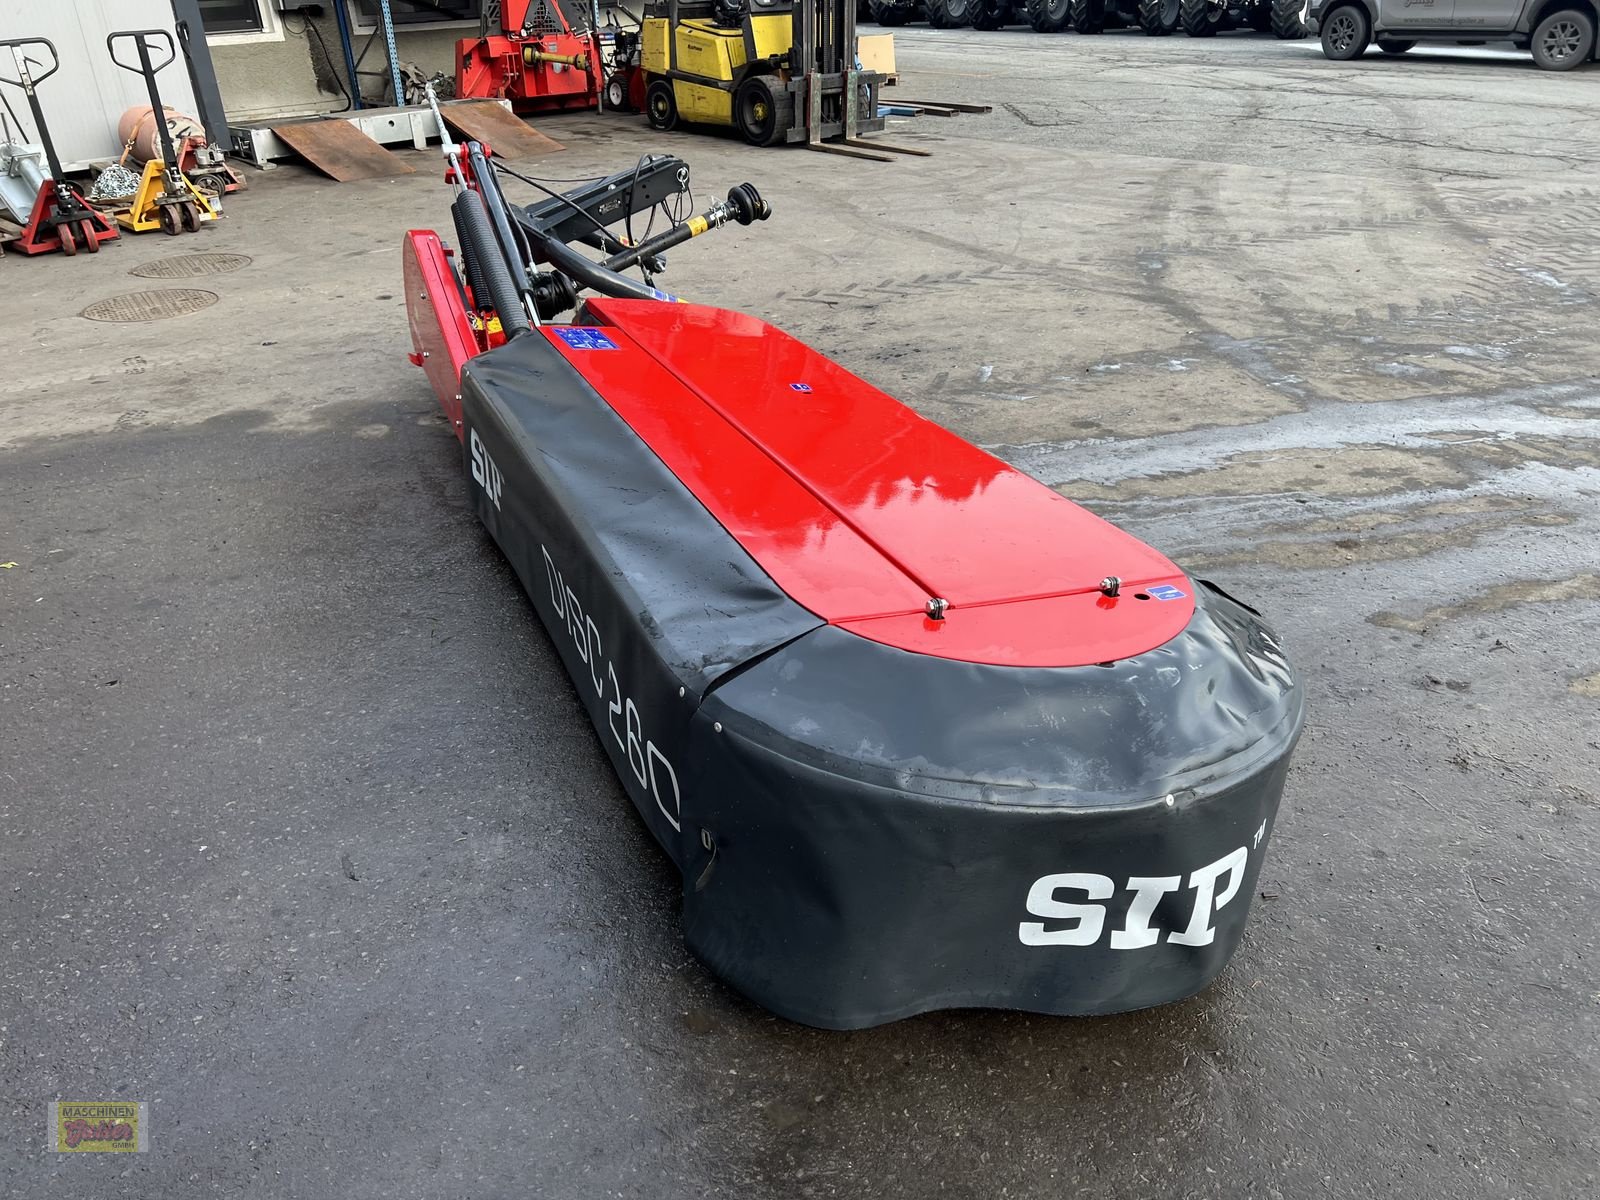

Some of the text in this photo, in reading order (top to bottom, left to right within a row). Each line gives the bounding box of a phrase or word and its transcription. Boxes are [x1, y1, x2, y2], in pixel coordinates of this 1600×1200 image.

[541, 543, 681, 833] DISC 260
[1018, 845, 1249, 950] SIP
